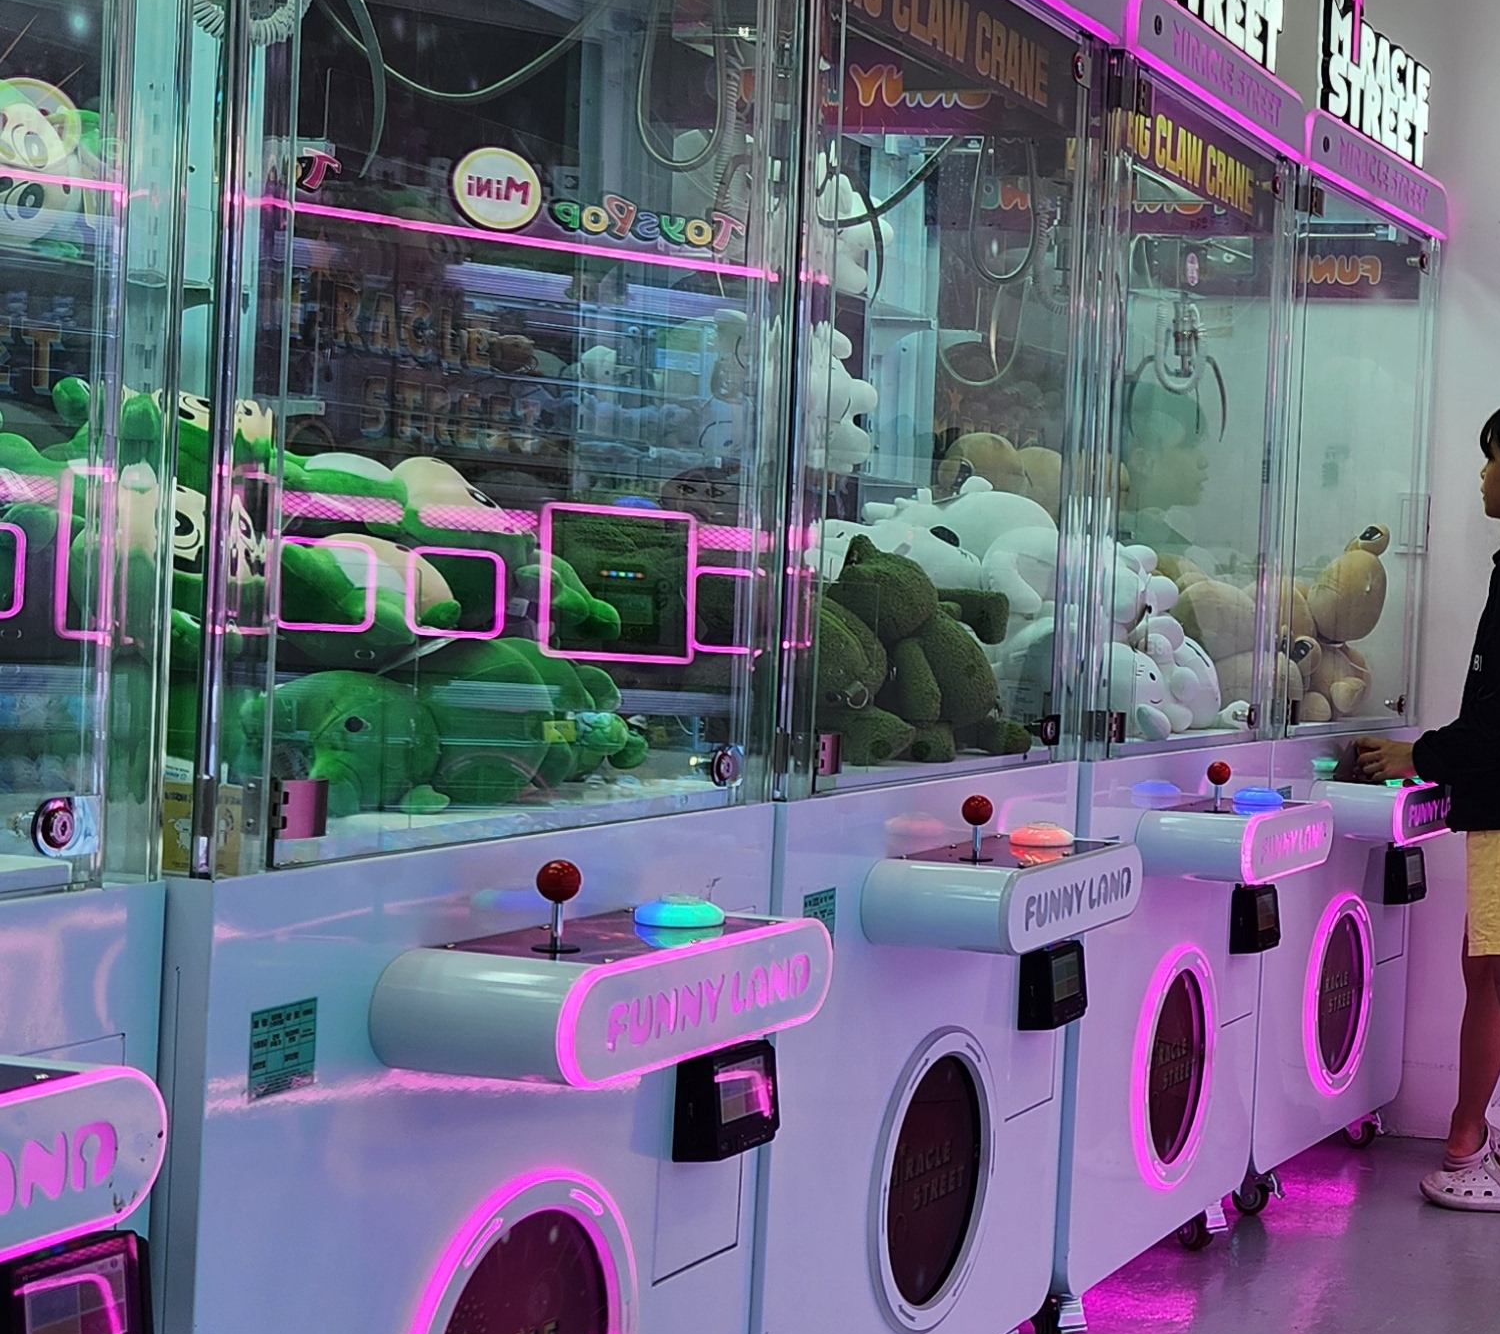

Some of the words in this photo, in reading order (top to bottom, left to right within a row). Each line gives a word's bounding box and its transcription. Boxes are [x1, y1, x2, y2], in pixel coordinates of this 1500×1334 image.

[975, 11, 1050, 108] CRANE
[1171, 19, 1235, 96] MIRACLE
[1237, 70, 1282, 128] STREET
[1328, 53, 1430, 169] STREET
[1154, 113, 1204, 188] CLAW
[1206, 144, 1254, 216] CRANE
[1025, 878, 1085, 933] FUNNY
[1087, 866, 1132, 906] LAND
[605, 973, 725, 1053] FUNNY
[730, 953, 811, 1015] LAND
